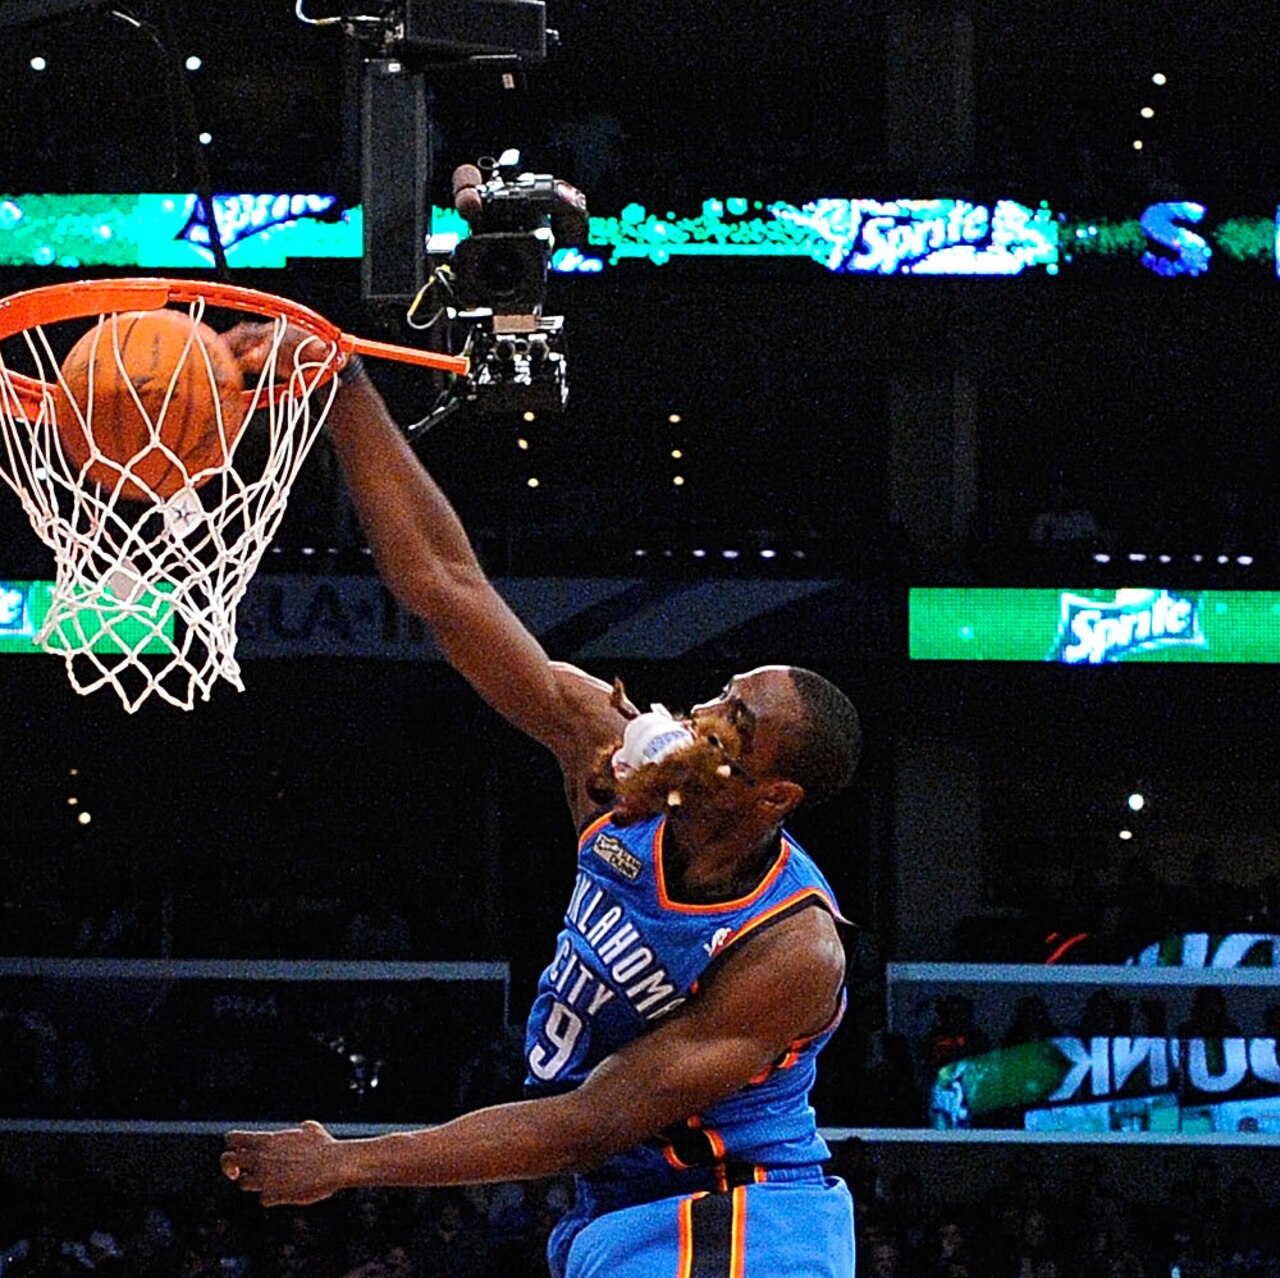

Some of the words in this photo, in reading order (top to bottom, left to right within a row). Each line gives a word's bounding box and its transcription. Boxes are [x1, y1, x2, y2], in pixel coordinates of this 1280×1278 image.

[1063, 589, 1192, 664] Sprite
[549, 939, 615, 1017] CITY
[528, 1000, 583, 1081] 9
